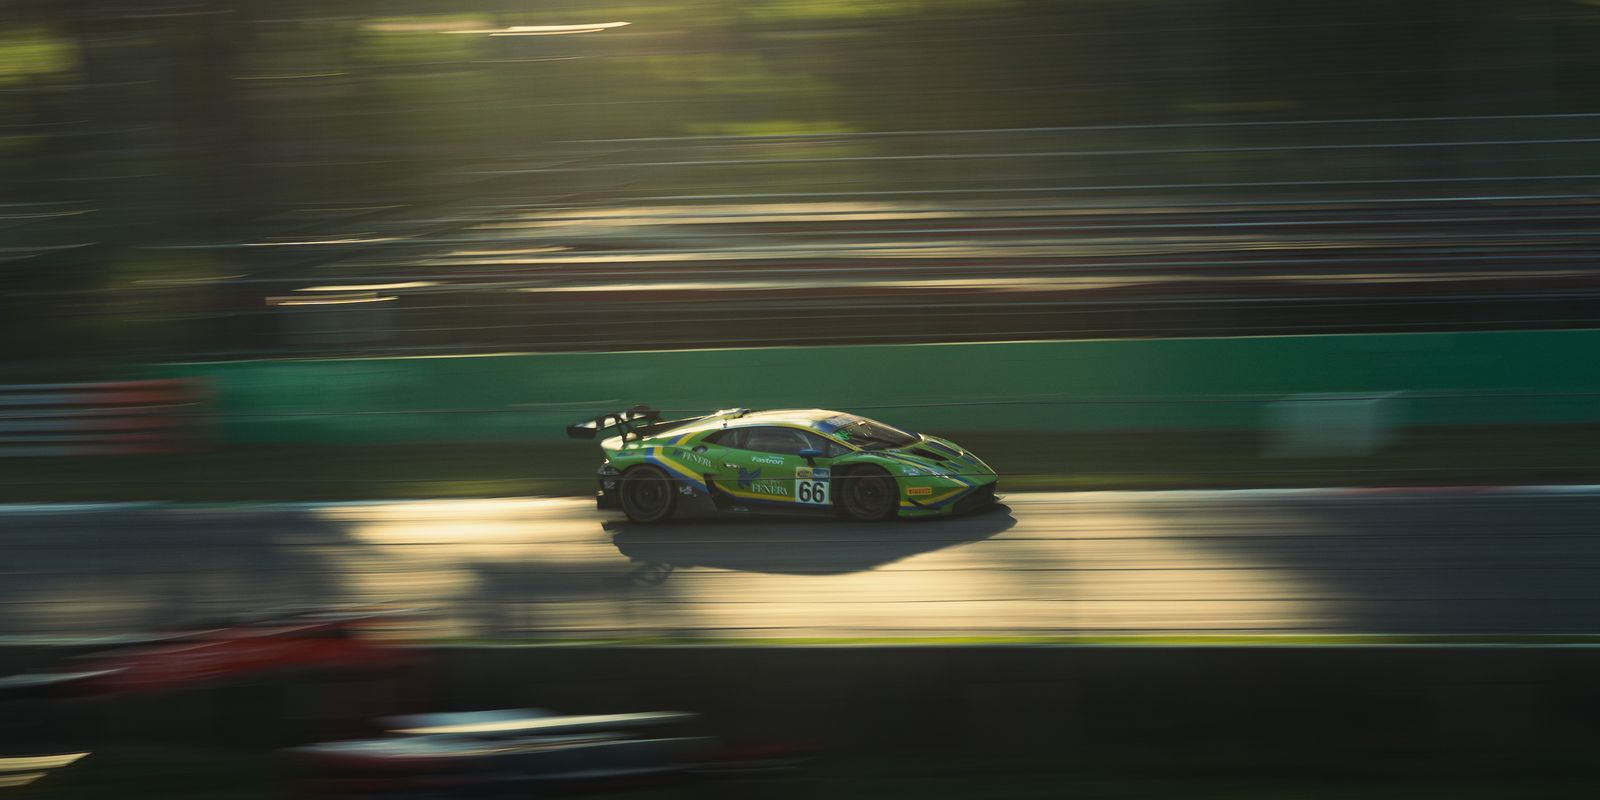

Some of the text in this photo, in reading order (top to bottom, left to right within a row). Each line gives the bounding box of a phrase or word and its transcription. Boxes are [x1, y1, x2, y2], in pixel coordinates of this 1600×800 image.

[752, 456, 784, 465] Fastron
[752, 483, 788, 496] FENERA
[799, 481, 825, 503] 66
